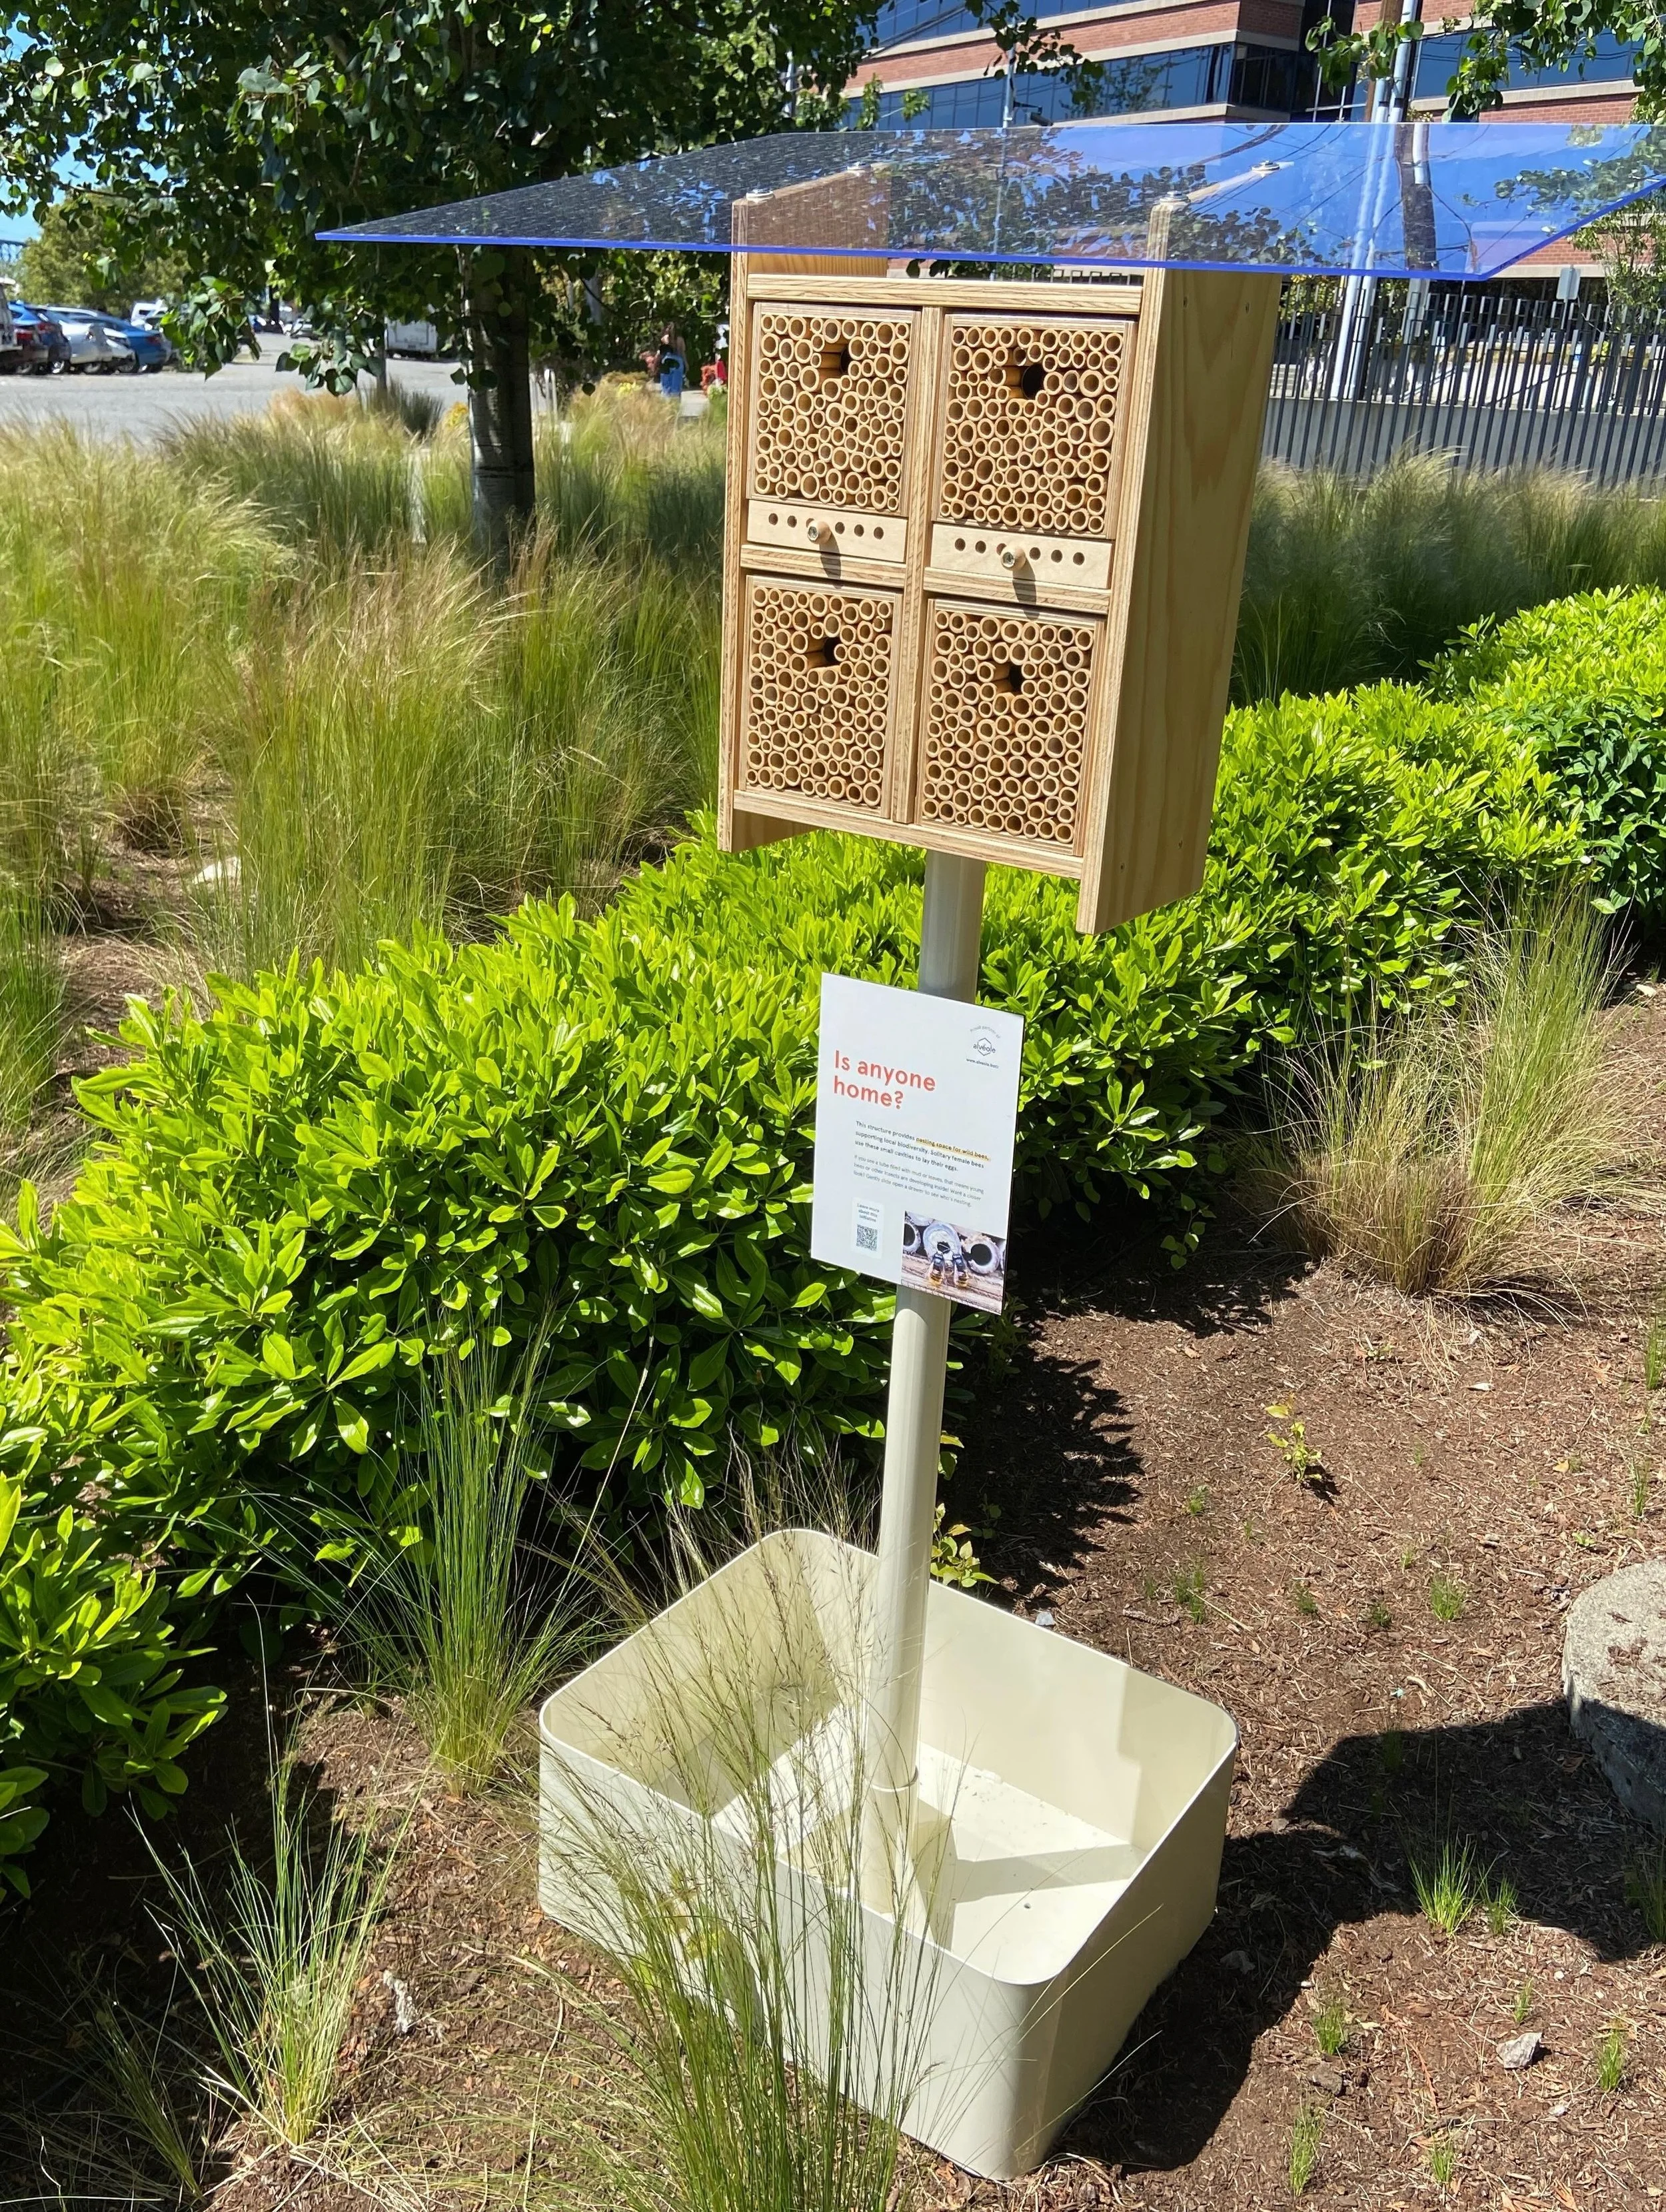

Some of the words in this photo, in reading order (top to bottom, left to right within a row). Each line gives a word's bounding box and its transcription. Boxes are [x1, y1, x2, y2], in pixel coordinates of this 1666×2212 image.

[974, 1043, 996, 1054] alvéole
[836, 1050, 850, 1071] Is
[858, 1061, 936, 1091] anyone
[834, 1076, 903, 1109] home?
[856, 1132, 883, 1143] supporting
[898, 1142, 929, 1154] biodiversity.
[930, 1150, 950, 1160] Solitary
[868, 1125, 892, 1134] structure
[892, 1131, 915, 1140] provides
[916, 1138, 935, 1147] nesting
[895, 1151, 914, 1160] cavities
